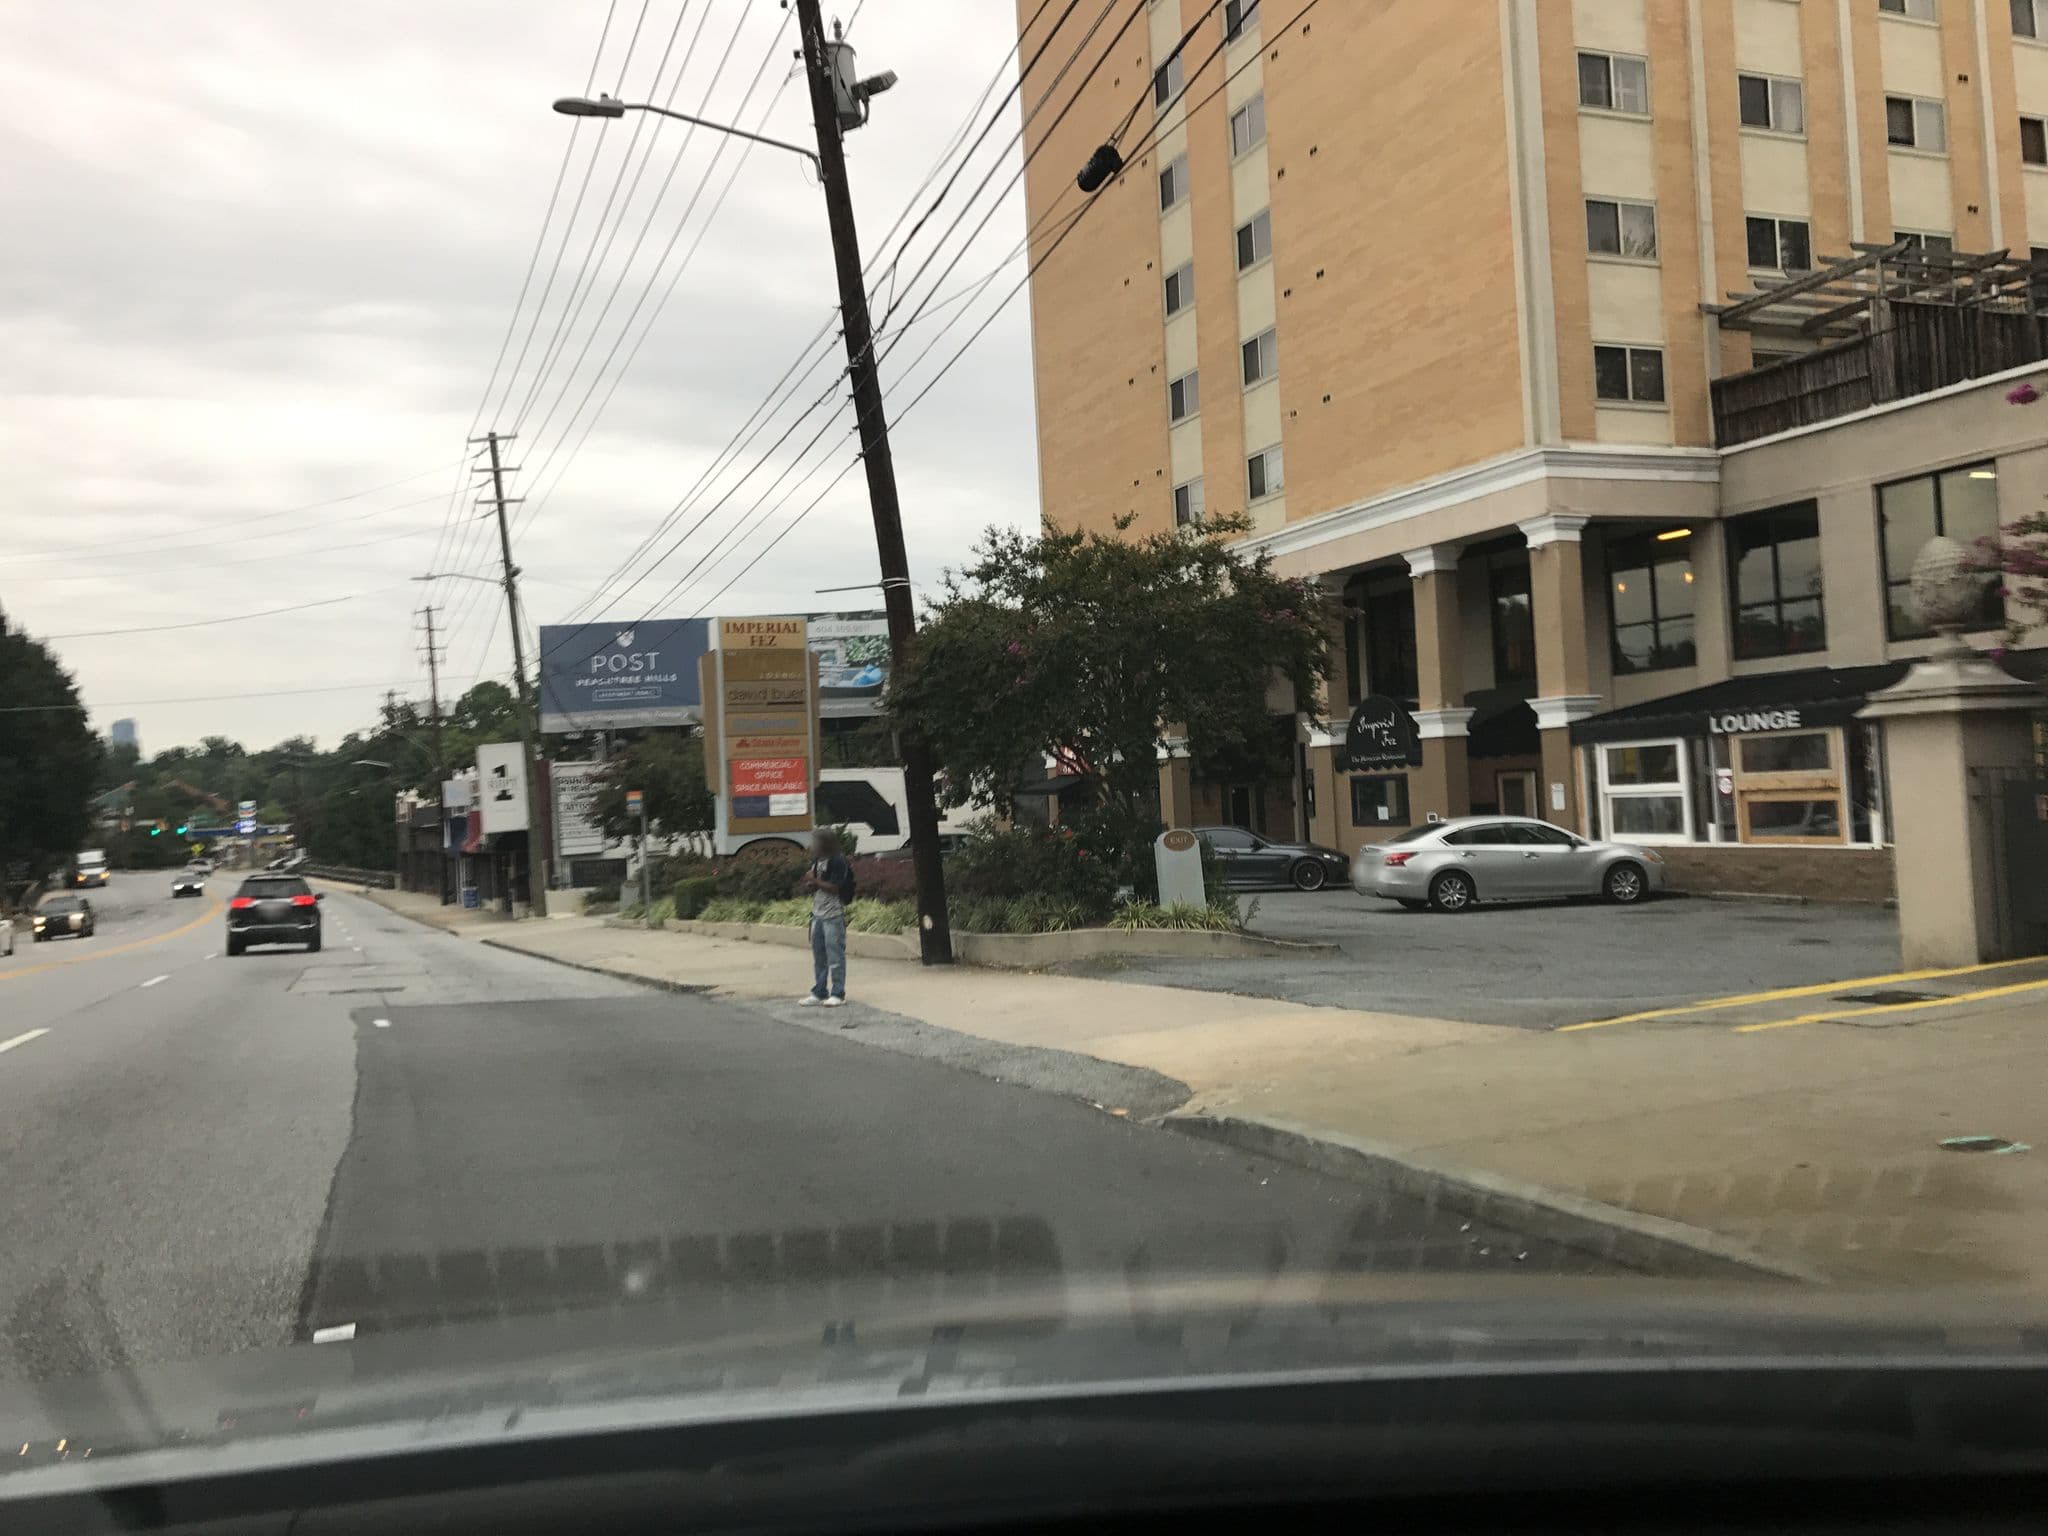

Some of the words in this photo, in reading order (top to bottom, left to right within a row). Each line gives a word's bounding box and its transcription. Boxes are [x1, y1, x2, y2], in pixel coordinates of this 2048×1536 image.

[724, 622, 801, 634] IMPERIAL
[749, 635, 777, 648] FEZ
[591, 651, 660, 674] POST
[644, 673, 678, 683] HILLS
[1709, 710, 1801, 733] LOUNGE
